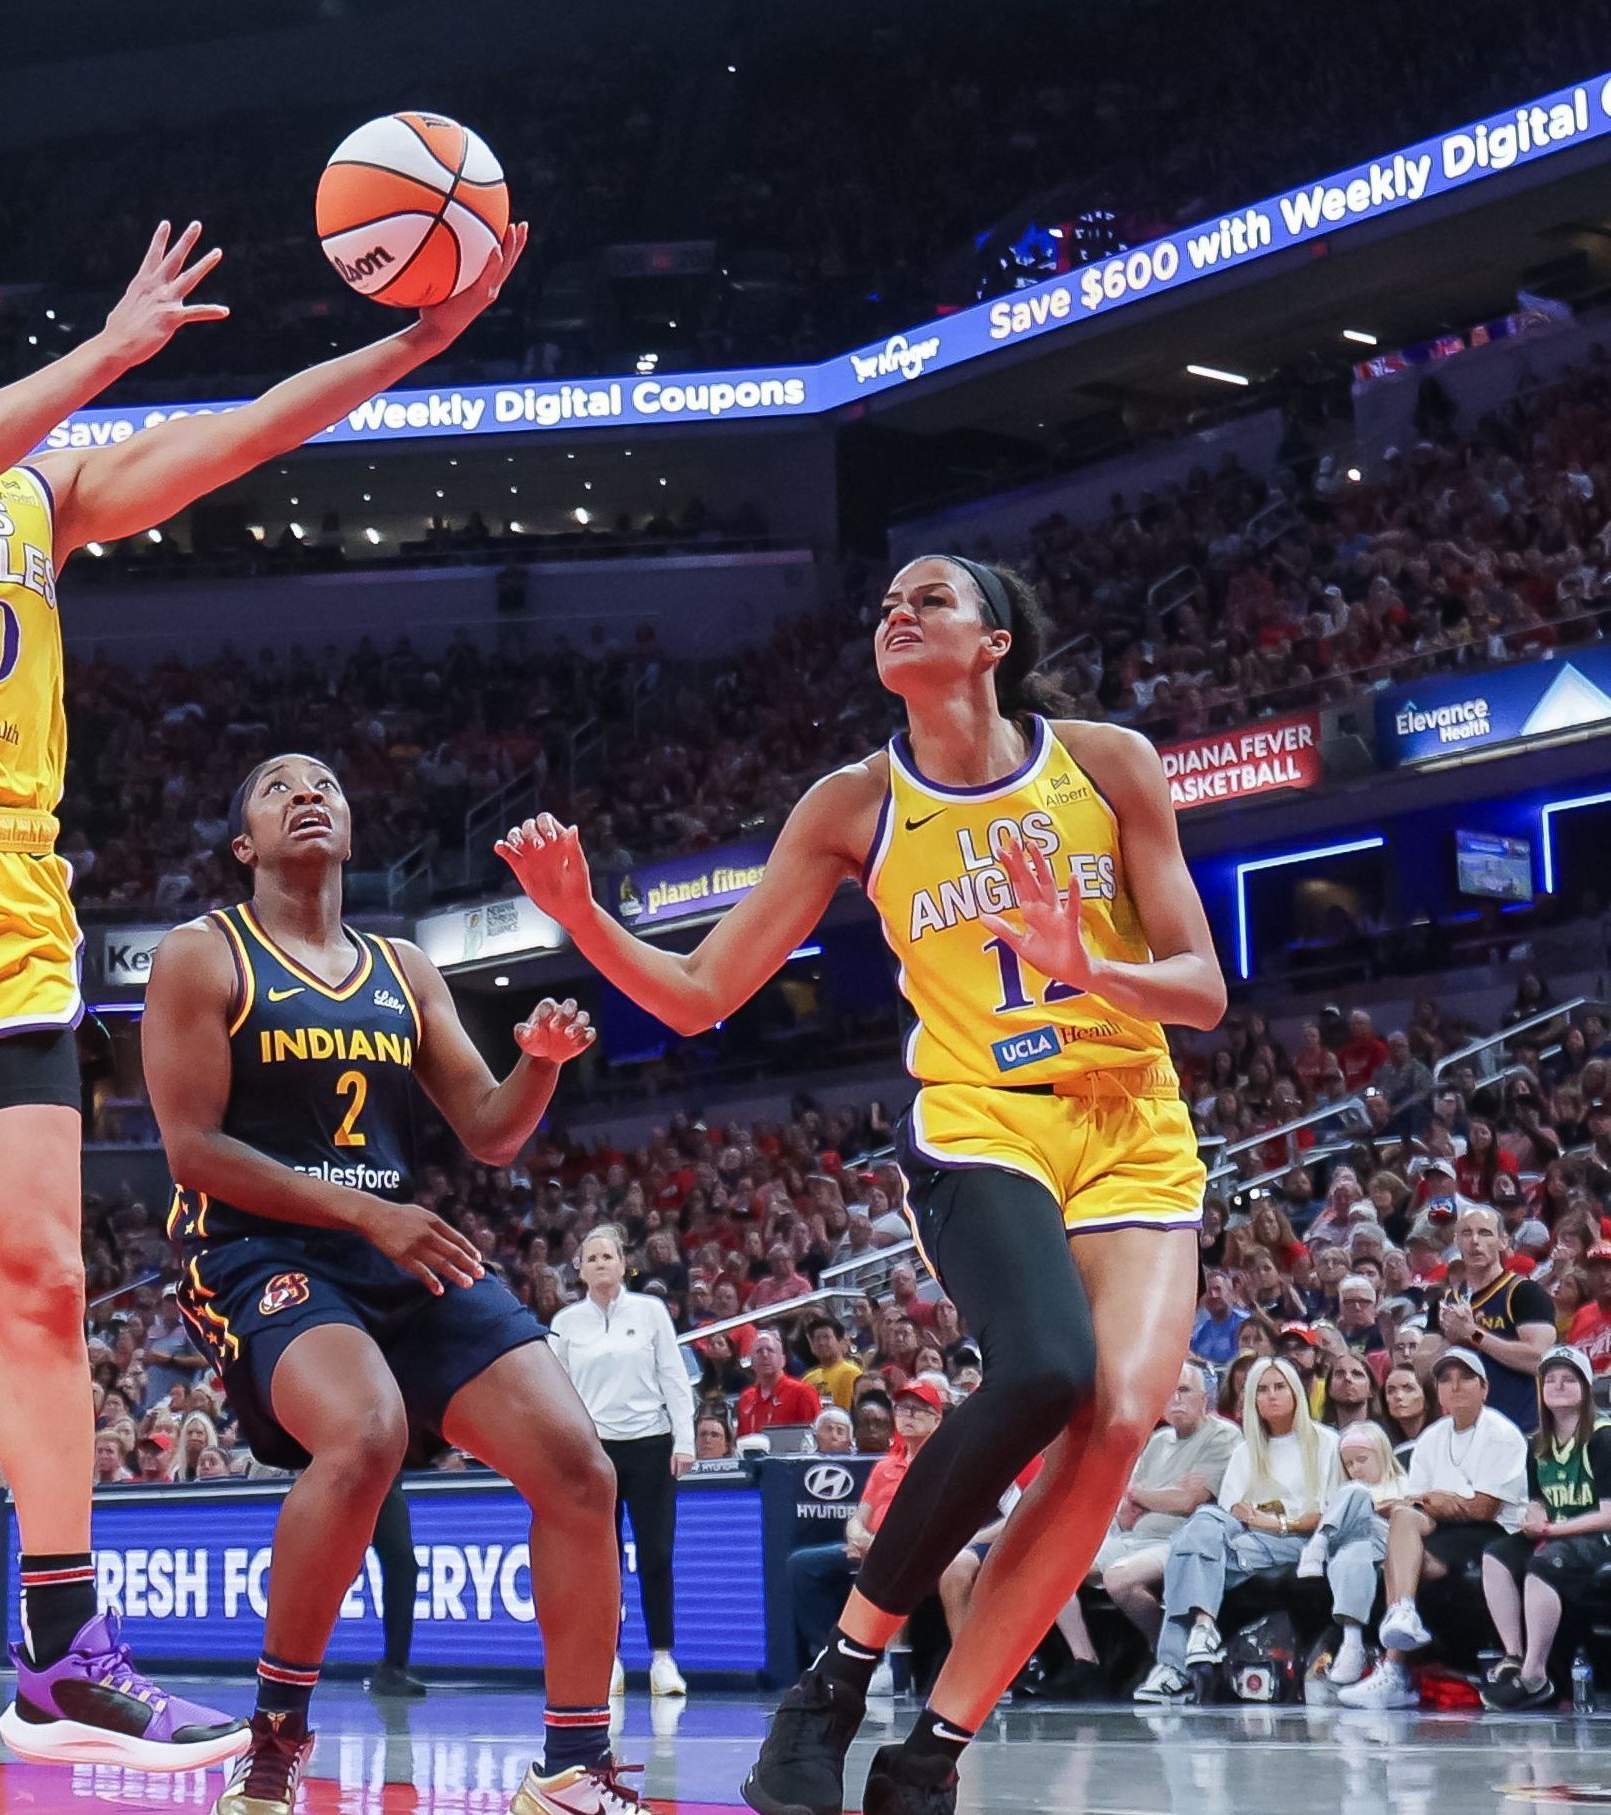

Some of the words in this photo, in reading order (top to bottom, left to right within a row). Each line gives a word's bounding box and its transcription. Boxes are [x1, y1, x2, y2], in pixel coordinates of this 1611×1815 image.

[989, 288, 1071, 339] Save
[1081, 241, 1179, 310] $600
[1188, 209, 1271, 270] with
[1279, 154, 1432, 236] Weekly
[1441, 87, 1588, 180] Digital
[334, 246, 395, 282] lson
[877, 336, 940, 380] Kroger
[348, 393, 485, 431] Weekly
[494, 383, 622, 426] Digital
[632, 377, 805, 416] Coupons
[37, 420, 133, 448] Save
[1396, 699, 1491, 735] Elevance
[1440, 718, 1490, 744] Health
[1162, 742, 1237, 779] DIANA
[1241, 724, 1314, 765] FEVER
[1046, 786, 1090, 809] Albert
[1171, 757, 1302, 804] ASKETBALL
[957, 812, 1060, 872] LOS
[648, 875, 709, 914] planet
[712, 864, 767, 894] fitnes
[910, 854, 1117, 942] ANGES
[108, 945, 156, 972] Ke
[374, 989, 406, 1016] Lilly
[260, 1027, 412, 1071] INDIANA
[1002, 1038, 1053, 1063] UCLA
[334, 1070, 367, 1146] 2
[797, 1504, 857, 1518] HYUNDA
[92, 1547, 208, 1619] RESH
[224, 1547, 272, 1618] FO
